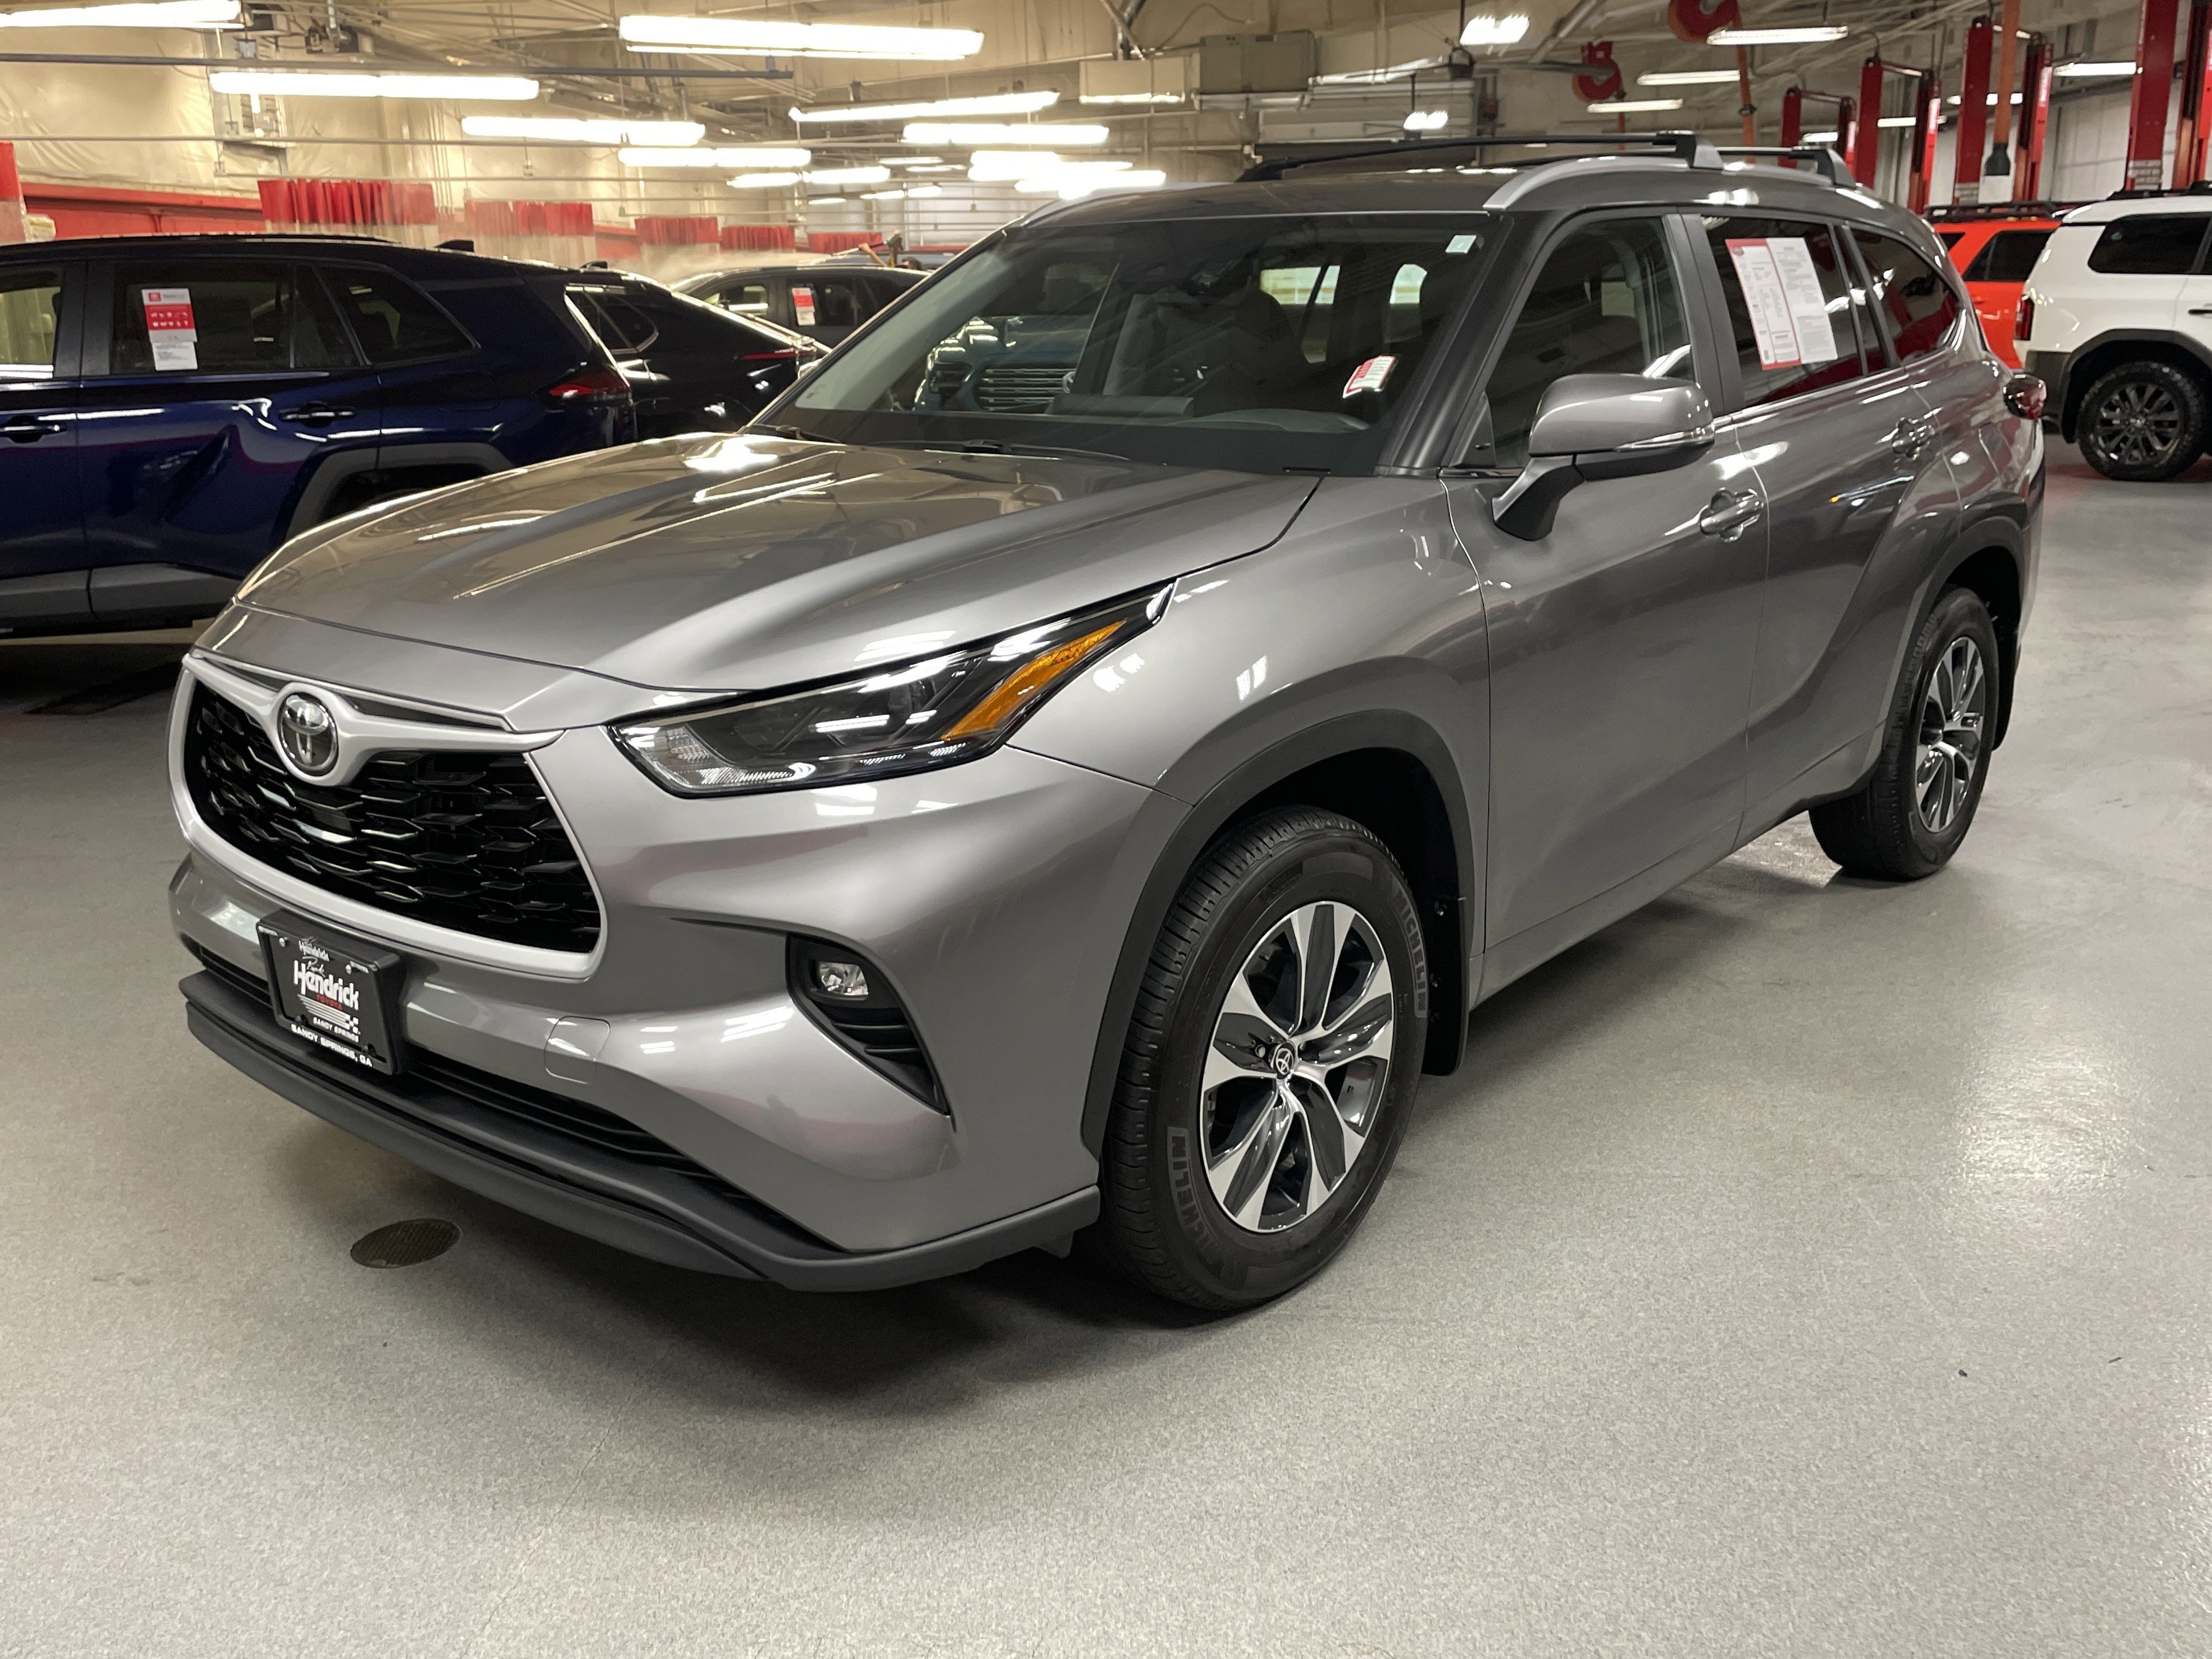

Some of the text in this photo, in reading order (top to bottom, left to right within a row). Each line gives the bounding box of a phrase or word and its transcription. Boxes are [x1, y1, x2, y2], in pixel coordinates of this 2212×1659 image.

[1393, 889, 1426, 1011] MICHELIN
[294, 960, 359, 1011] Hendrick
[291, 1024, 318, 1042] SANDY
[313, 1017, 333, 1030] SANDY
